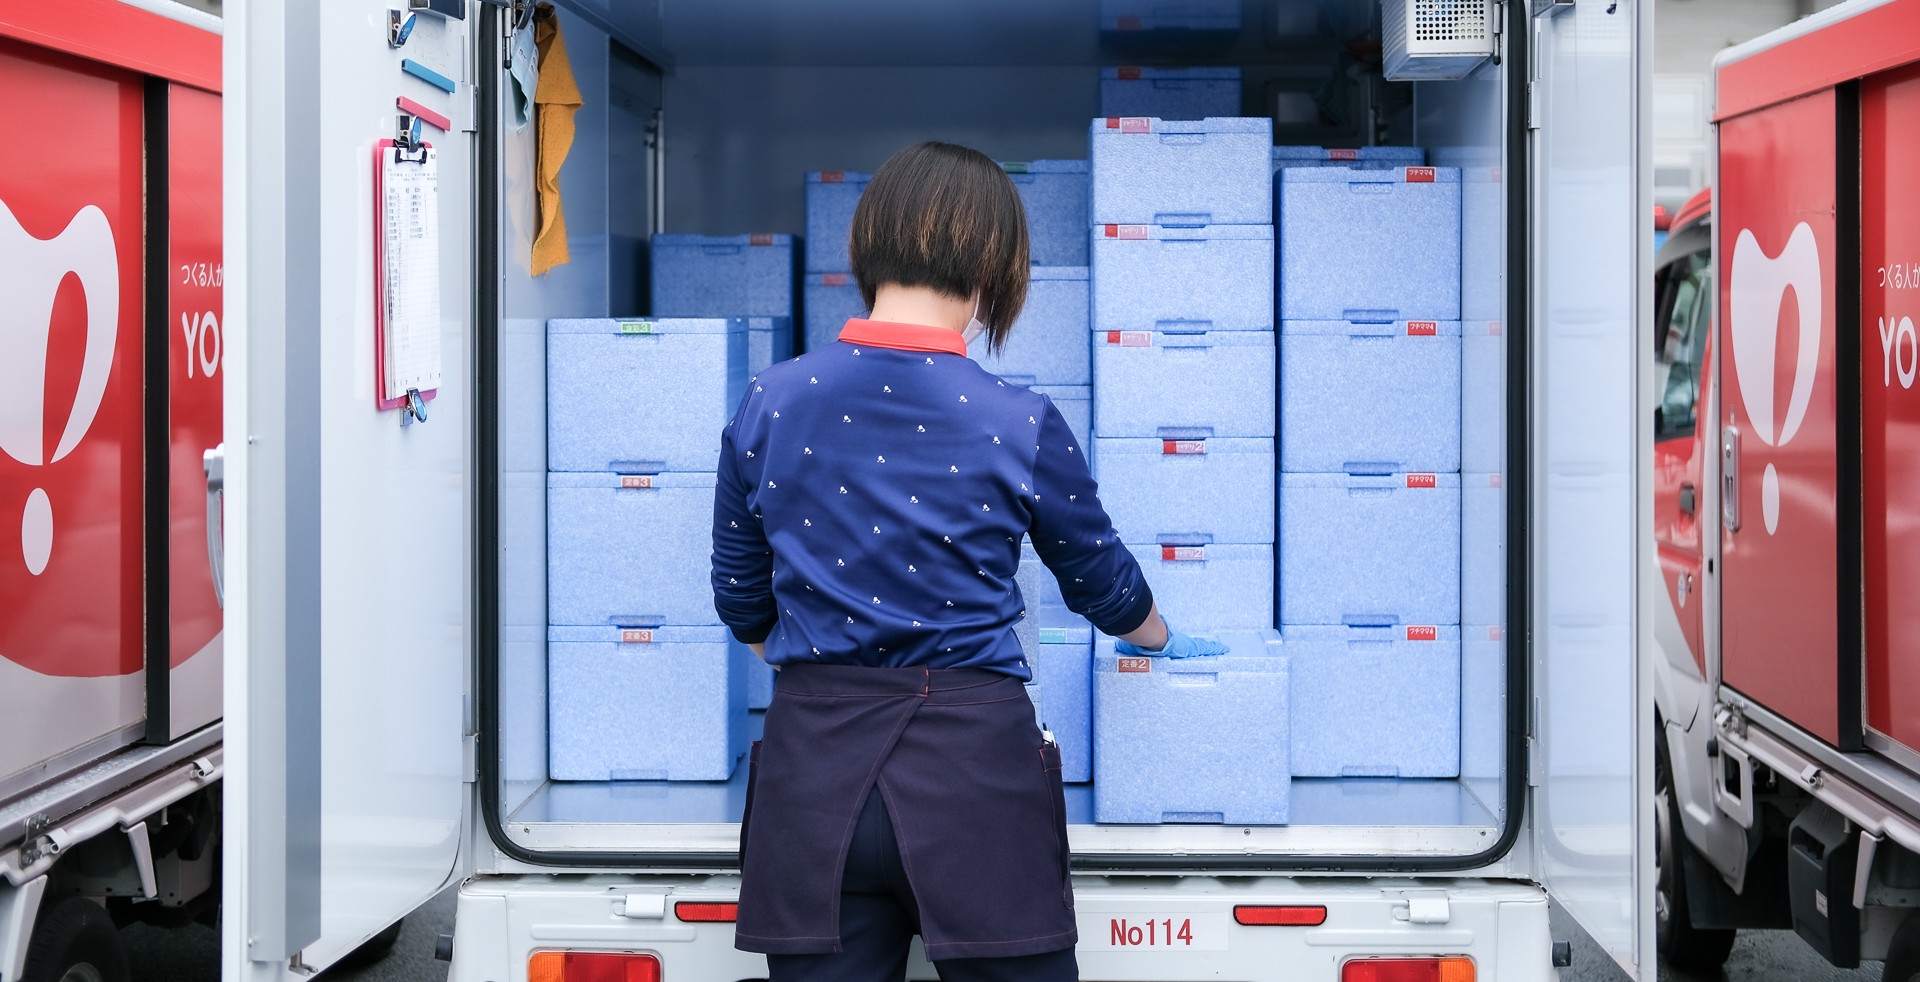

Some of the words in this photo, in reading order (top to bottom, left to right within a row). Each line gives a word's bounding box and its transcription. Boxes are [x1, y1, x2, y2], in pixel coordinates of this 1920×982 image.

[181, 310, 224, 379] YO
[1878, 315, 1920, 389] YO
[1121, 660, 1146, 669] 定番2
[1111, 918, 1193, 946] No114
